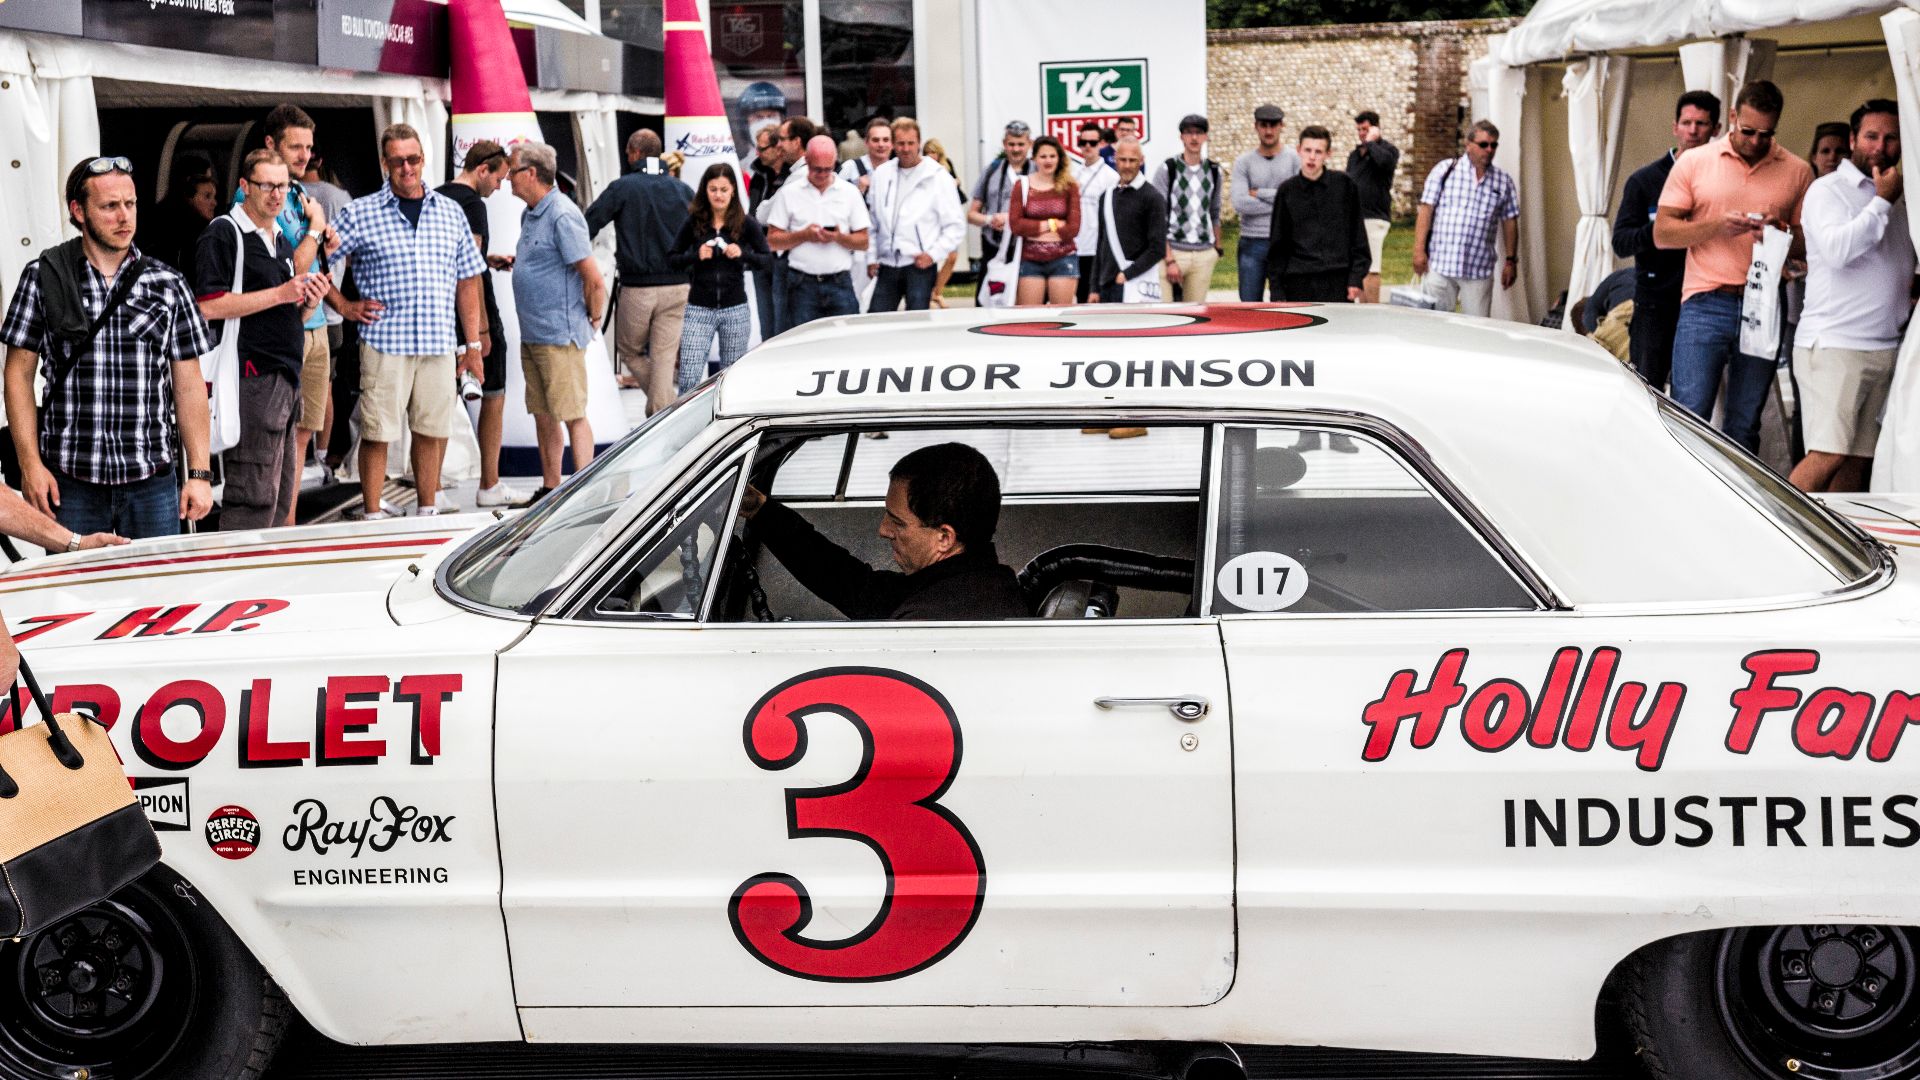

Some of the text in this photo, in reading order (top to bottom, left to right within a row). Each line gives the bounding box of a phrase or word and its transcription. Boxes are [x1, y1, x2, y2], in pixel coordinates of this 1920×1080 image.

[342, 14, 352, 35] RED
[1059, 68, 1131, 112] TAG
[796, 359, 1315, 397] JUNIOR JOHNSON
[1236, 567, 1290, 596] 117
[94, 598, 291, 641] H.P.
[0, 673, 463, 771] ROLET
[1361, 645, 1688, 772] Holly
[135, 795, 183, 813] PION
[1503, 794, 1920, 848] INDUSTRIES
[206, 817, 259, 833] PERFECT
[210, 828, 255, 843] CIRCLE
[727, 665, 987, 984] 3
[293, 867, 449, 886] ENGINEERING
